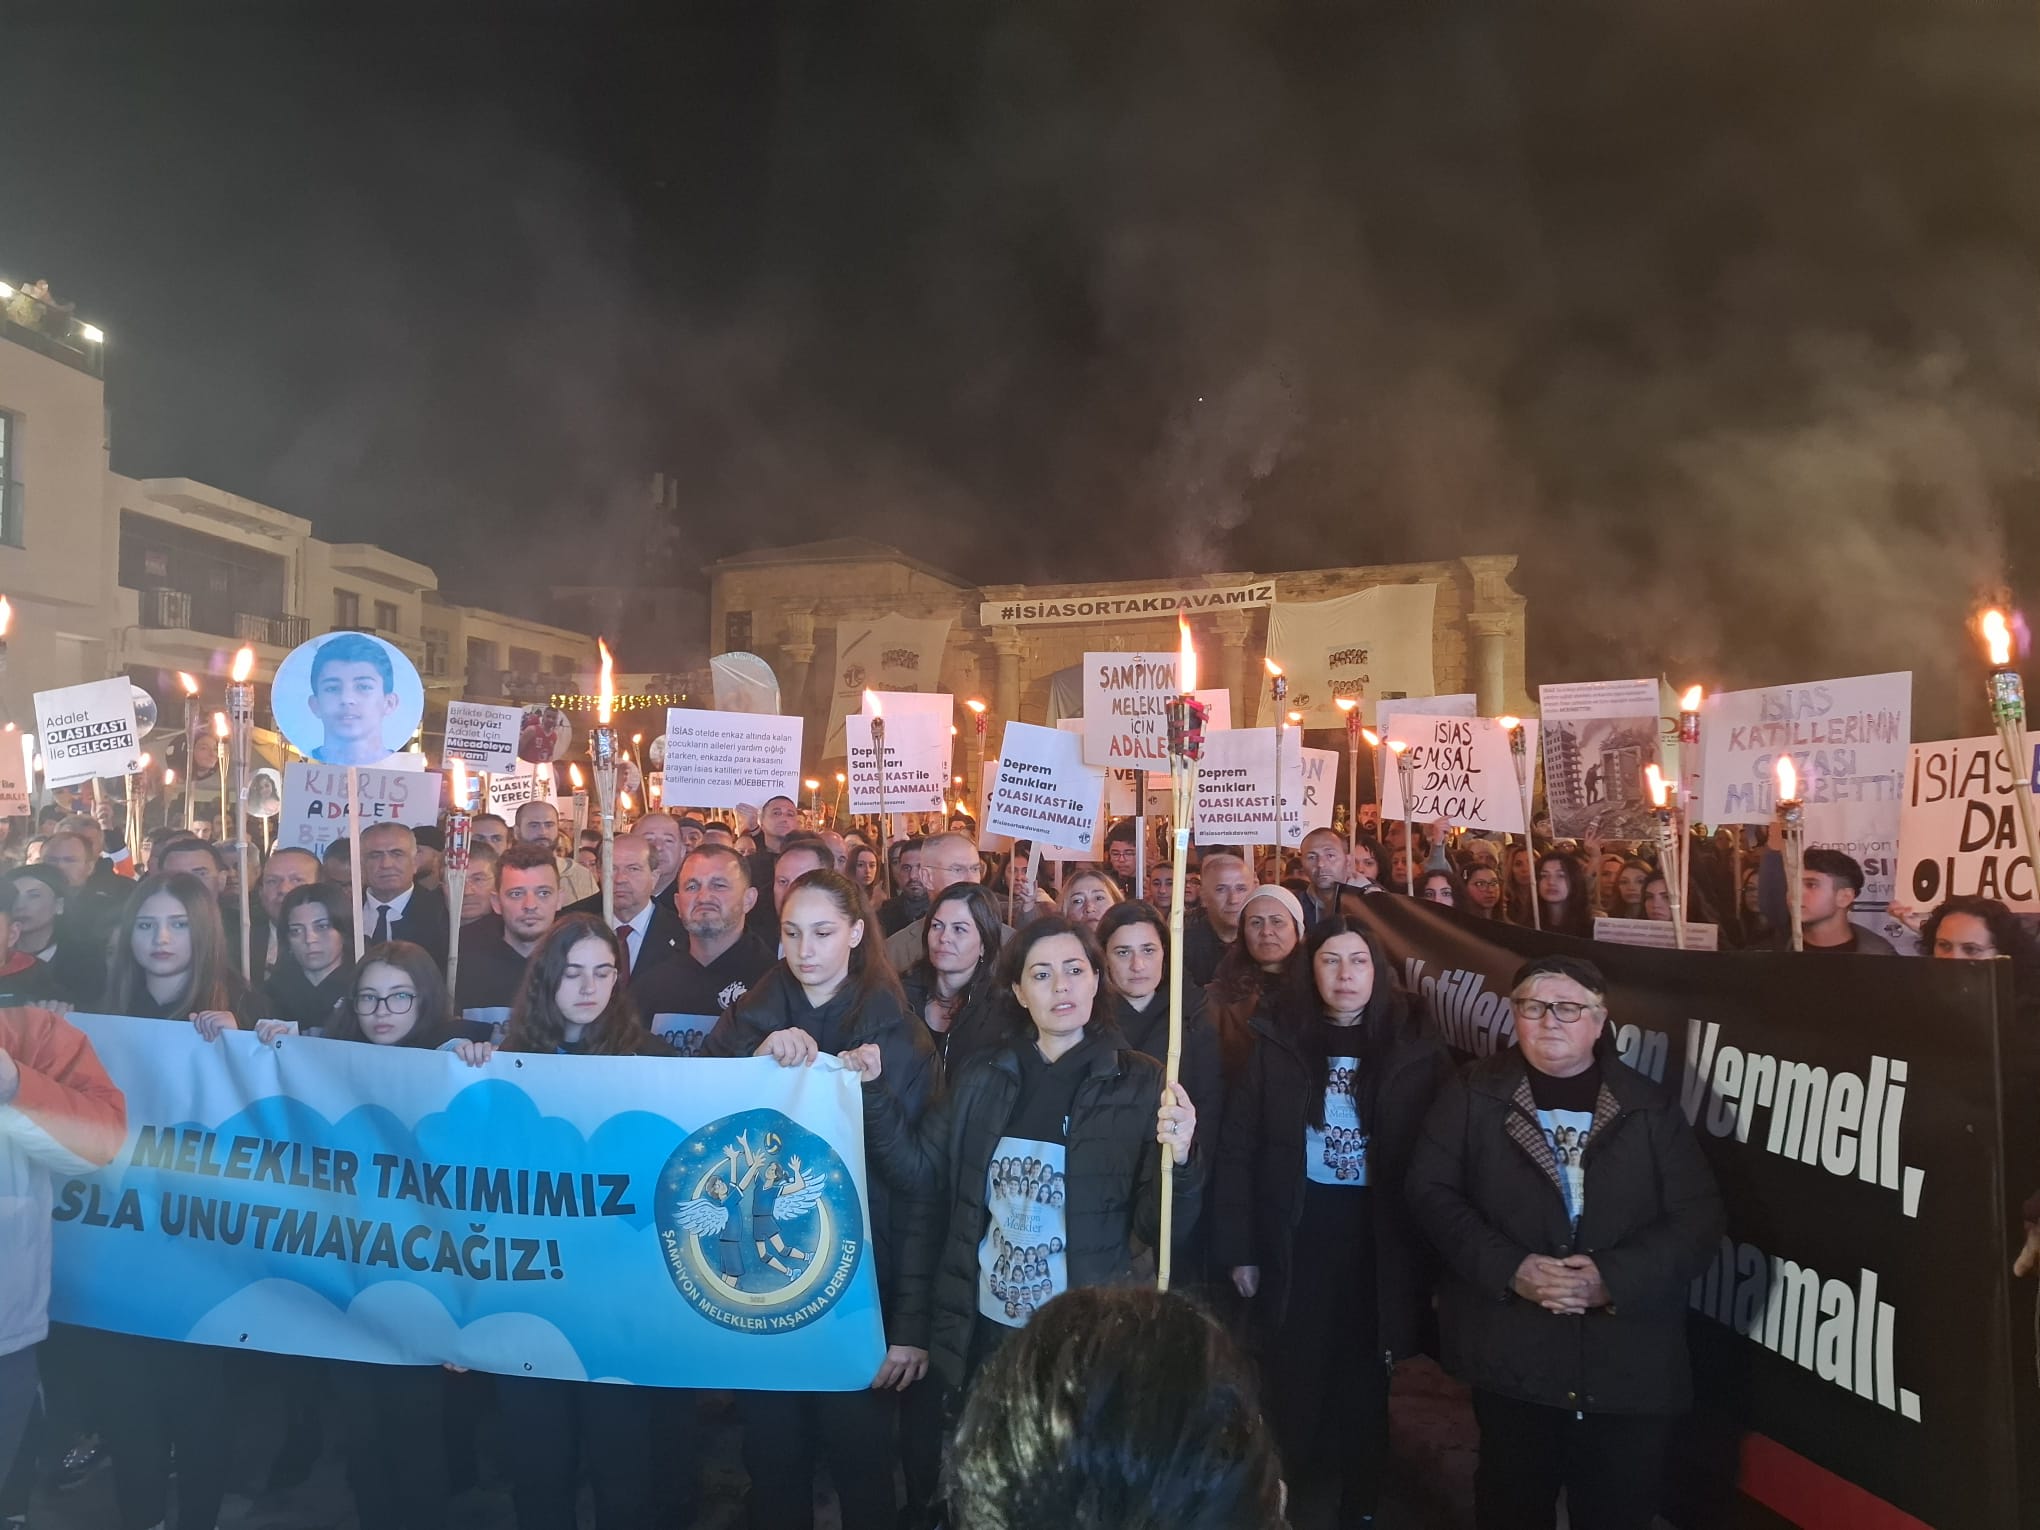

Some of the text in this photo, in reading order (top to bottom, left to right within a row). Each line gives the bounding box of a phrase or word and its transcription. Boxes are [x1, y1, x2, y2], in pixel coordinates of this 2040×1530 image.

[1099, 659, 1177, 693] ŞAMPİYON
[1759, 685, 1833, 722] İSİAS
[46, 710, 89, 728] Adalet
[449, 707, 512, 720] Birlikte Daha
[48, 720, 126, 743] OLASI KAST
[449, 717, 502, 729] Güçlüyüz!
[448, 727, 480, 738] Adalet
[694, 729, 720, 738] otelde
[721, 730, 744, 739] enkaz
[745, 732, 771, 741] altında
[772, 734, 792, 742] kalan
[1434, 719, 1472, 746] İSİAS
[68, 734, 133, 757] GELECEK!
[447, 737, 512, 752] Mücadeleye
[667, 740, 787, 755] çocukların aileleri yardım çığlığı
[1109, 734, 1168, 759] ADALE
[700, 754, 733, 763] enkazda
[734, 756, 751, 764] para
[752, 756, 783, 765] kasasını
[852, 759, 903, 769] Sanıları
[1003, 758, 1052, 776] Deprem
[1752, 748, 1857, 780] CZASI
[665, 764, 693, 774] arayan
[714, 766, 742, 775] katilleri
[754, 768, 769, 776] tüm
[770, 768, 799, 778] deprem
[853, 769, 929, 782] OLAS KAST ile
[1198, 768, 1247, 780] Deprem
[1911, 748, 2016, 808] İSİAS
[490, 781, 523, 793] OLASI
[665, 775, 706, 785] katillerinin
[707, 777, 732, 786] cezası
[1000, 773, 1057, 792] Sanıkları
[1198, 782, 1256, 793] Sanıkları
[1422, 772, 1474, 793] DAVA
[998, 788, 1033, 803] OLASI
[1034, 795, 1068, 809] KAST
[1068, 799, 1084, 812] ile
[1198, 795, 1287, 808] OLASI KAST ie
[996, 802, 1092, 829] YARGILANMALI!
[1912, 855, 2034, 903] OLAC
[1679, 1018, 1926, 1219] Vermeli,
[130, 1125, 636, 1218] MELEKLER TAKIMIMIZ
[51, 1179, 565, 1282] SLA UNUTMAYACAĞIZ!
[661, 1229, 857, 1330] ŞAMPİYON MELEKLERİ YAŞATMA DERNEĞİ
